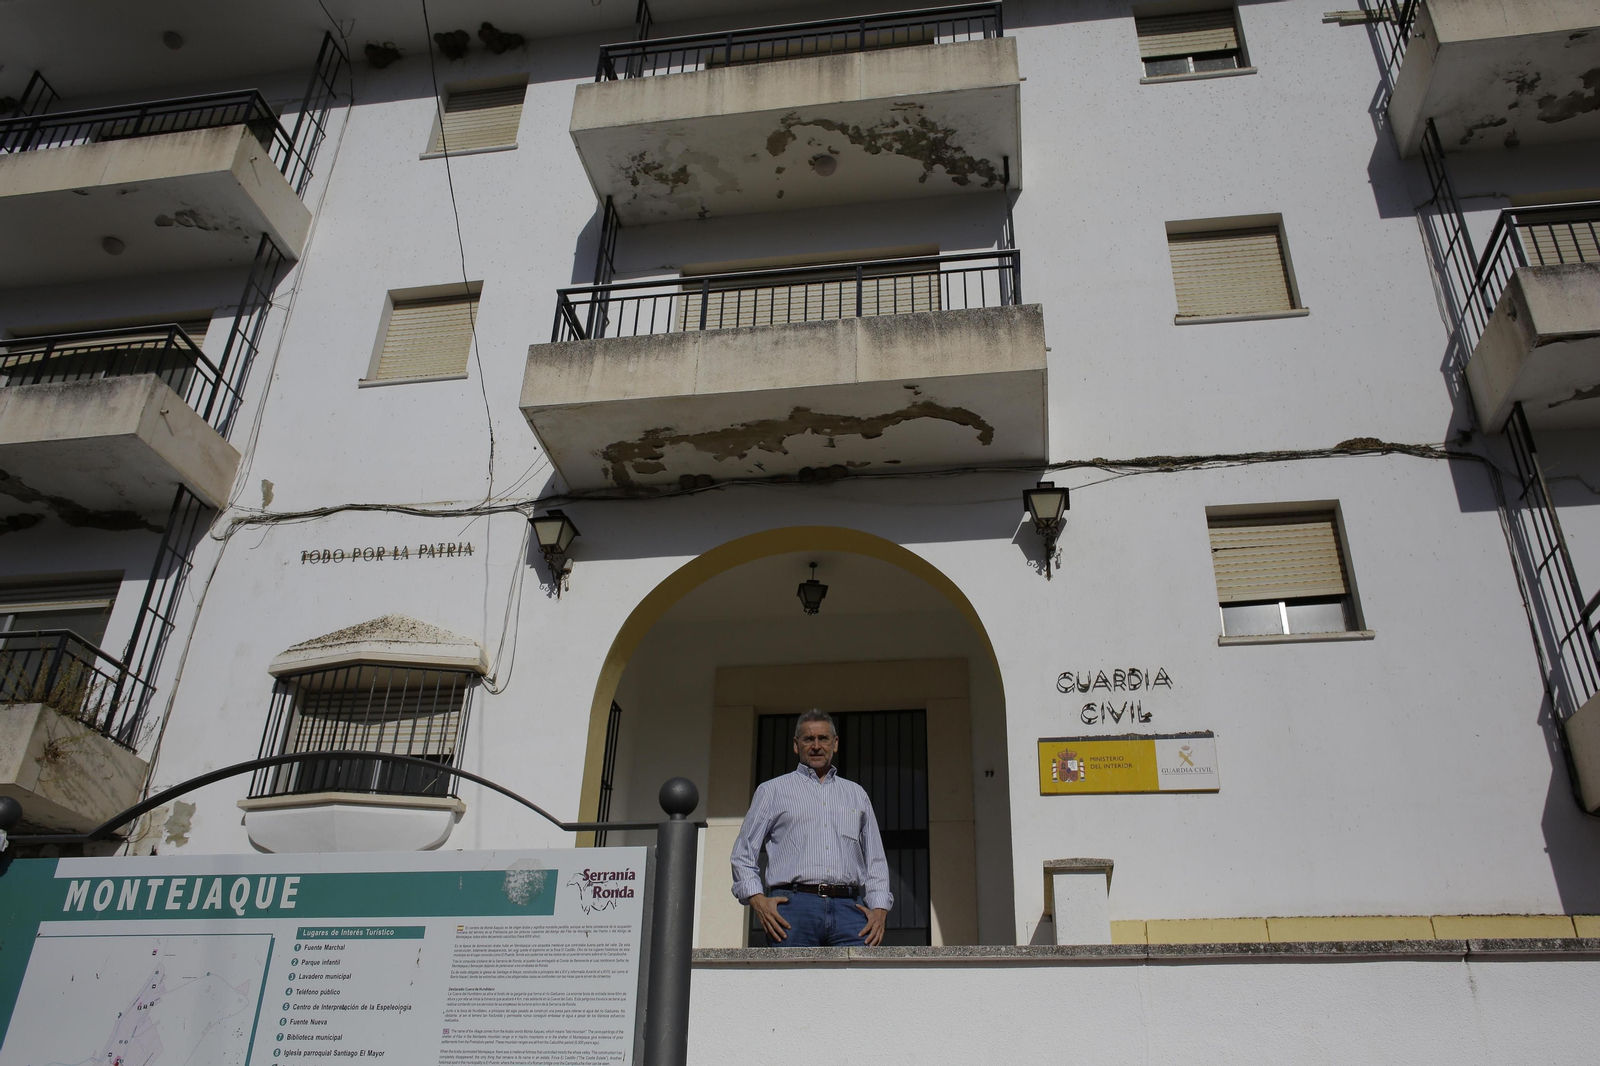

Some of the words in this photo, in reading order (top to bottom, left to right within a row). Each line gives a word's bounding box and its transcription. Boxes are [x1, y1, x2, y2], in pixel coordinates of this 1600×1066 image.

[300, 548, 345, 565] TODO
[352, 546, 386, 562] POR
[392, 545, 409, 561] LA
[418, 542, 474, 559] PATRIA
[1056, 666, 1173, 693] GUARDIA
[1080, 700, 1153, 724] CIVIL
[583, 868, 635, 881] Serranía
[62, 876, 301, 916] MONTEJAQUE
[592, 886, 634, 898] Ronda
[303, 928, 328, 937] Lugares
[341, 928, 363, 936] Interés
[366, 928, 395, 936] Turístico
[325, 973, 351, 981] municipal
[320, 988, 340, 996] público
[316, 1034, 342, 1042] municipal
[303, 1049, 332, 1058] parroquial
[333, 1049, 358, 1058] Santiago
